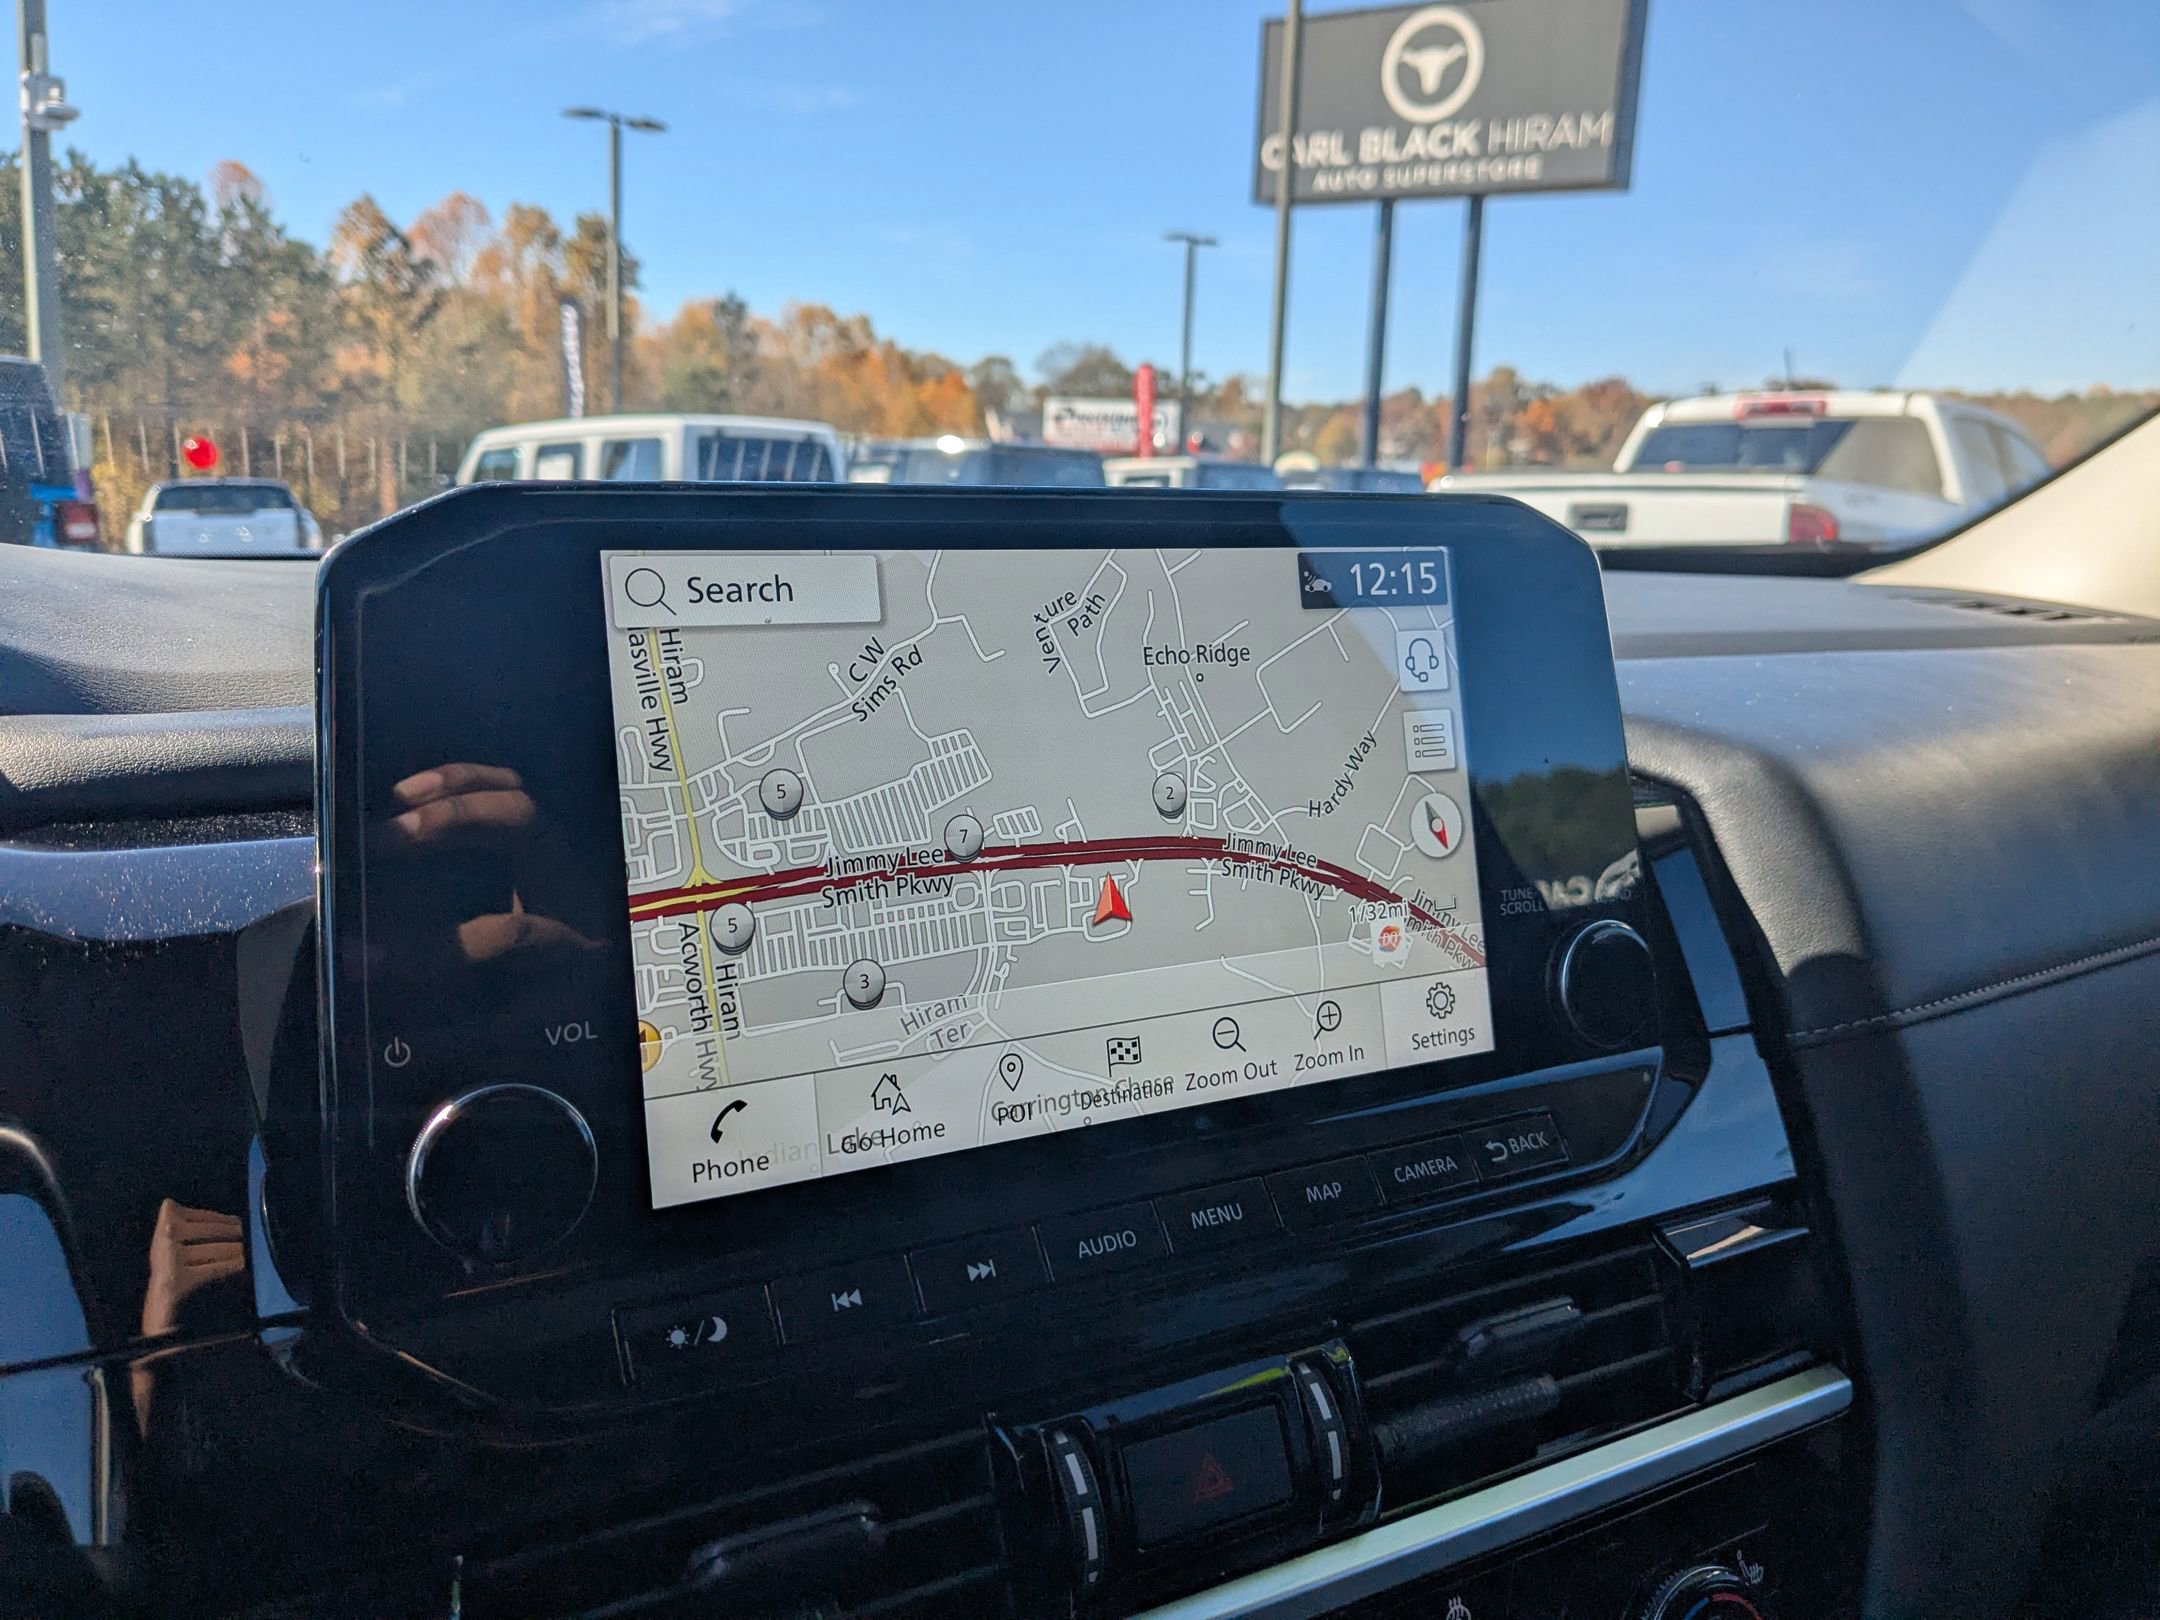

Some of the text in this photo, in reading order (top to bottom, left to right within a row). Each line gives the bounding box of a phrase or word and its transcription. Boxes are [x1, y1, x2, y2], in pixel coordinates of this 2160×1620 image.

[1358, 120, 1482, 164] BLACK
[1487, 109, 1615, 153] HIRAM
[1312, 153, 1544, 193] AUTO SUPERSTORE
[687, 574, 794, 604] Search
[1350, 561, 1439, 596] 12:15
[1066, 592, 1107, 638] Path
[1033, 592, 1078, 674] Venture
[659, 628, 689, 705] Hiram
[848, 635, 888, 684] C W
[1142, 643, 1251, 666] Echo Ridge
[851, 643, 926, 723] Sims Rd
[645, 716, 673, 772] Hwy
[1307, 729, 1378, 818] Hardy Way
[776, 784, 788, 799] 5
[1164, 785, 1175, 801] 2
[958, 828, 969, 845] 7
[1222, 833, 1318, 868] Jimmy Lee
[824, 845, 945, 878] Jimmy Lee
[821, 873, 954, 908] Smith Pkwy
[1221, 858, 1327, 901] Smith Pkwy
[1349, 898, 1409, 923] 1/32mi
[1500, 900, 1545, 917] SCROLL
[727, 919, 740, 935] 5
[678, 921, 713, 1032] Acworth
[858, 973, 871, 991] 3
[715, 963, 741, 1041] Hiram
[899, 994, 969, 1036] Hiram
[544, 1020, 598, 1046] VOL
[929, 1020, 970, 1050] Ter
[1411, 1027, 1475, 1052] Settings
[1294, 1043, 1366, 1074] Zoom In
[1185, 1060, 1279, 1093] Zoom Out
[1080, 1080, 1174, 1111] Destination
[997, 1101, 1033, 1127] POI
[840, 1121, 947, 1155] Go Home
[1508, 1131, 1550, 1155] BACK
[691, 1153, 771, 1184] Phone
[1393, 1155, 1458, 1184] CAMERA
[1305, 1181, 1343, 1204] MAP
[1190, 1202, 1244, 1231] MENU
[1076, 1229, 1138, 1260] AUDIO
